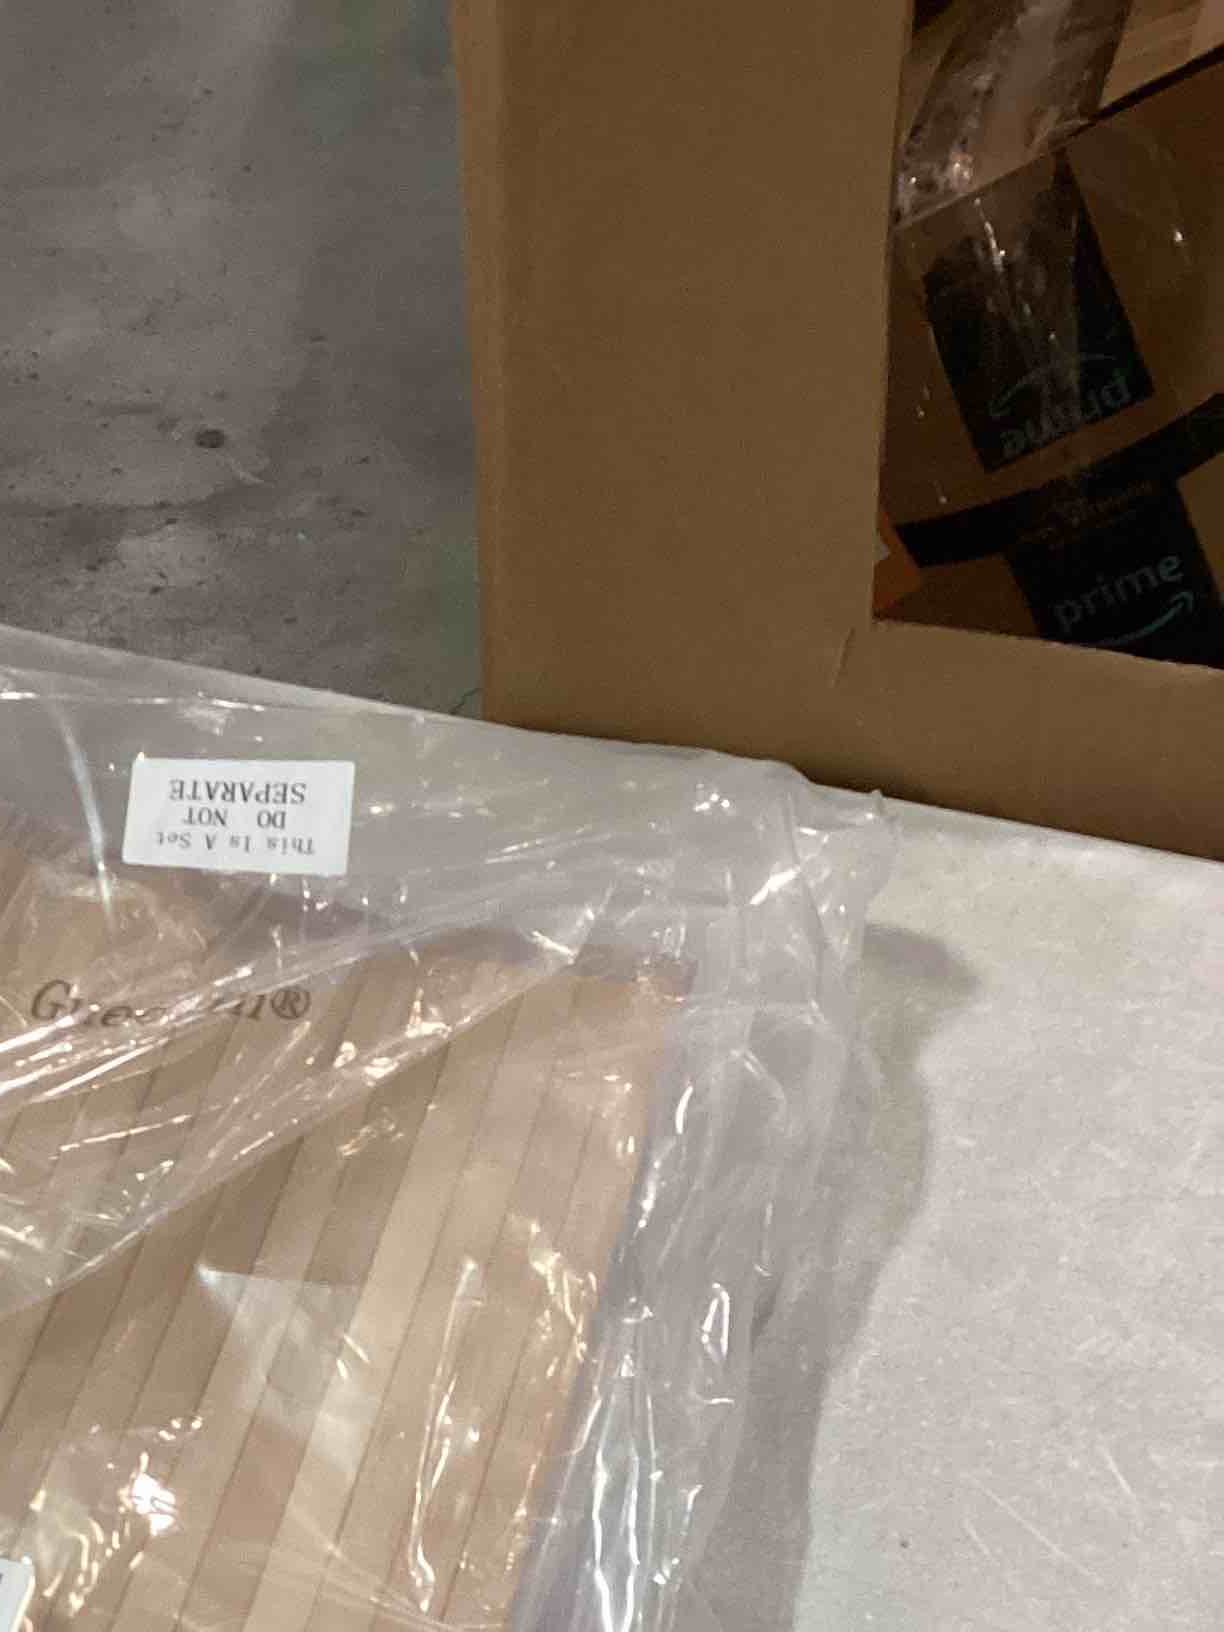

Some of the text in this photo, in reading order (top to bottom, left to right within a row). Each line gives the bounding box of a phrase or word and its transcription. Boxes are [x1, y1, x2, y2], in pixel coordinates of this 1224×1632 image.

[1054, 555, 1184, 633] prime
[169, 778, 307, 805] SEPARATE
[183, 806, 287, 830] DO NOT
[157, 830, 192, 849] Set
[205, 831, 217, 851] A
[267, 836, 316, 855] This
